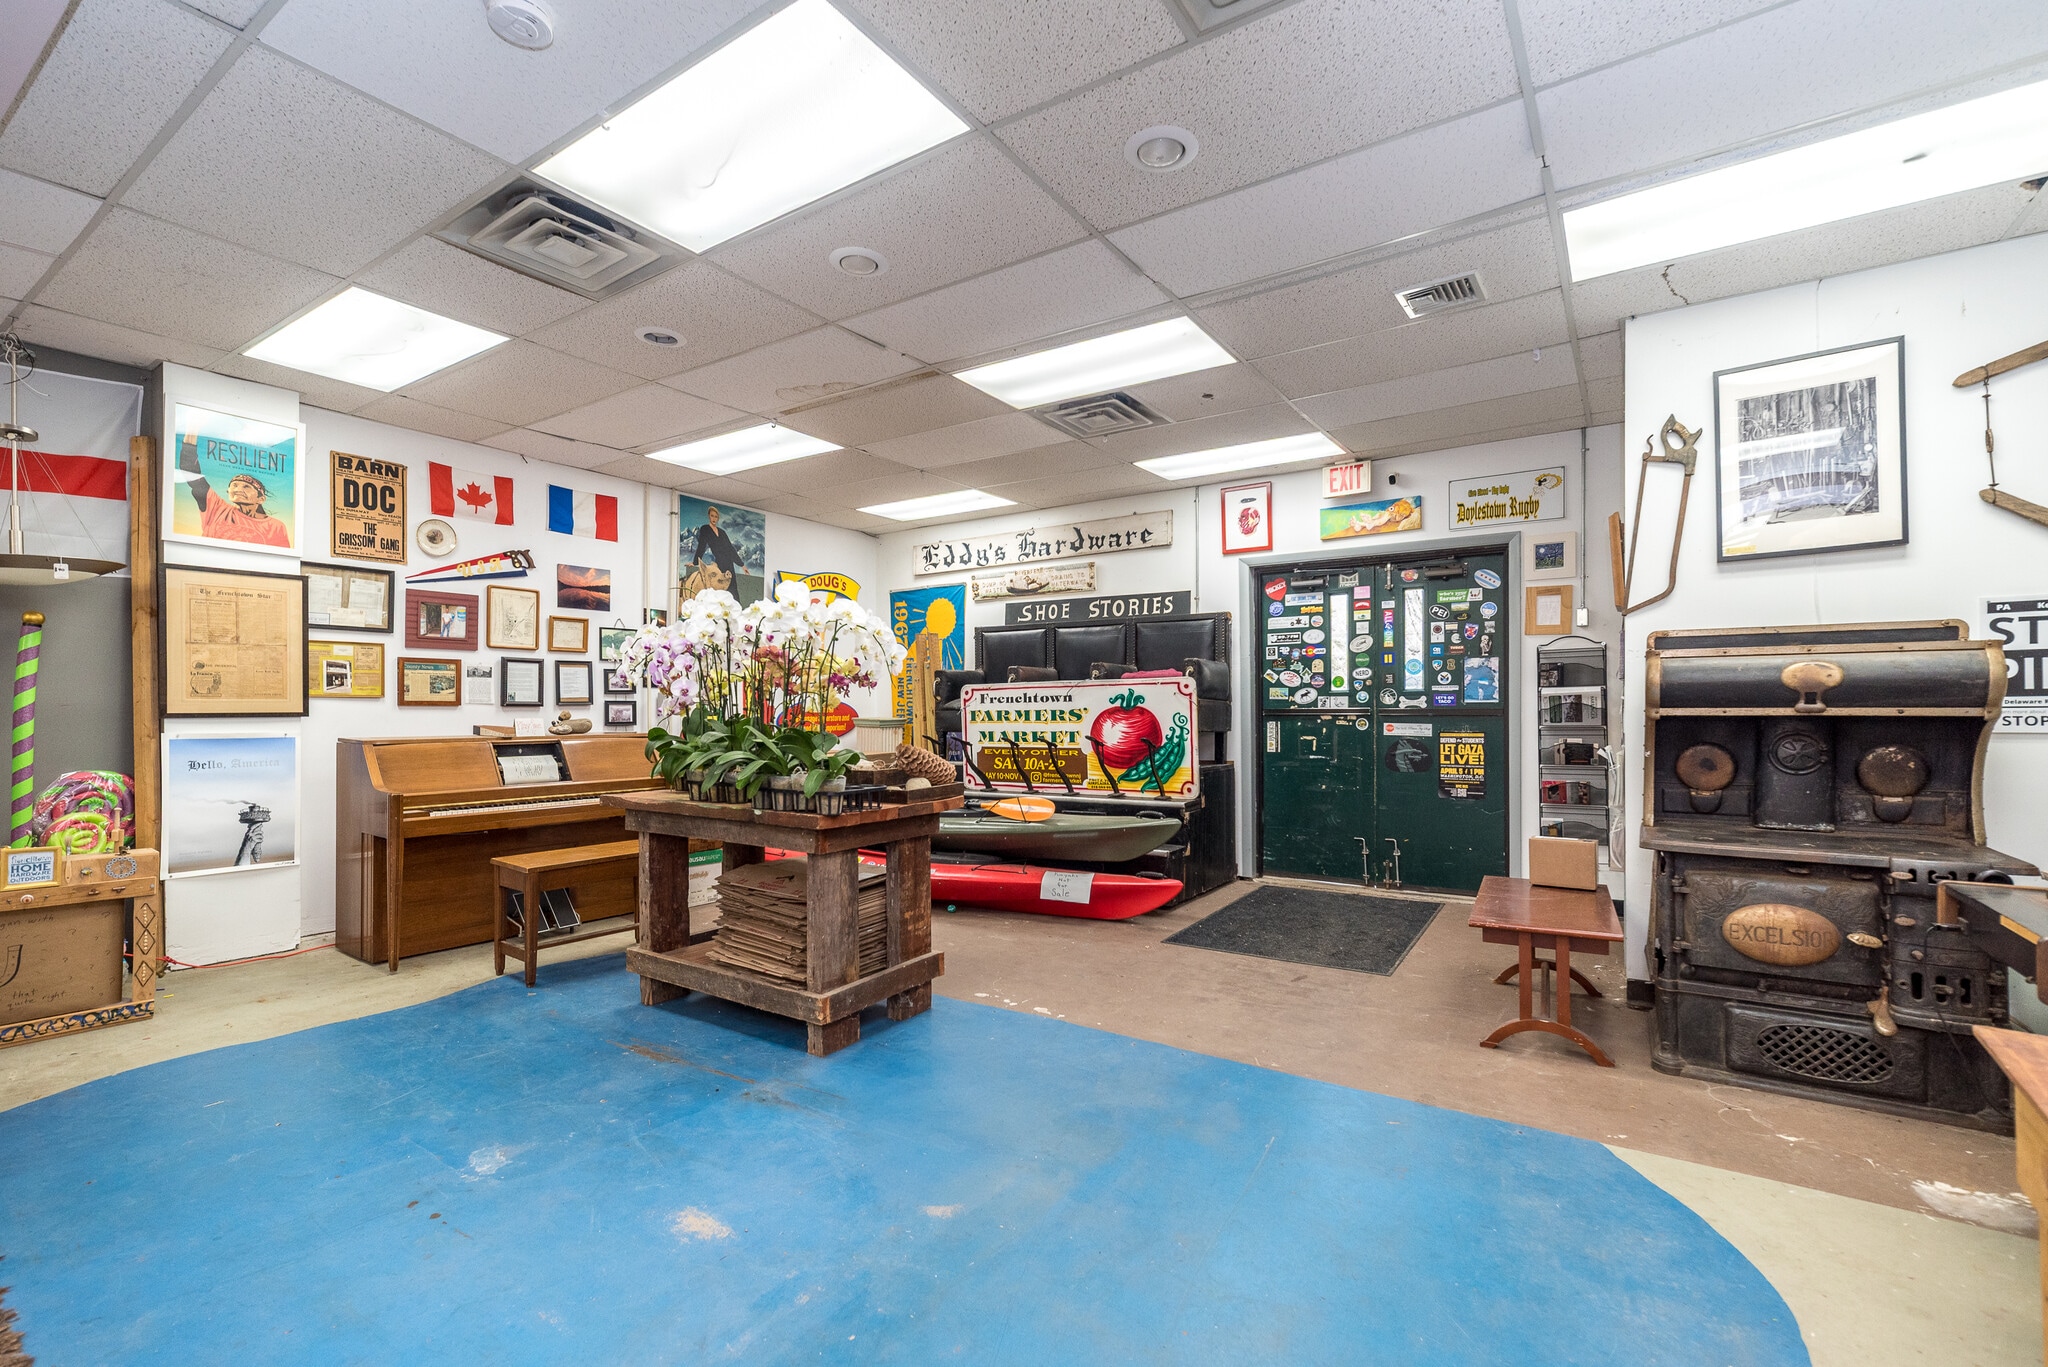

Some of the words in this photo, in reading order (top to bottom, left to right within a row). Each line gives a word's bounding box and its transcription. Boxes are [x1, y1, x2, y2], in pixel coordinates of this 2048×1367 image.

[206, 440, 288, 473] RESILIENT
[338, 456, 399, 478] BARN
[1330, 464, 1363, 493] EXIT
[343, 478, 396, 514] DOC
[1457, 501, 1507, 525] Doylestown
[1509, 495, 1540, 520] Rugby
[363, 522, 378, 536] THE
[339, 532, 377, 549] GRISSOM
[380, 538, 401, 552] GANG
[922, 543, 1006, 572] Eddy's
[1016, 527, 1154, 562] Hardware
[1018, 603, 1070, 622] SHOE
[1088, 596, 1174, 618] STORIES
[1431, 606, 1448, 618] PEI
[893, 600, 908, 650] 1967
[897, 677, 905, 698] NEW
[980, 692, 1073, 704] Frenchtown
[969, 707, 1089, 725] FARMERS'
[978, 730, 1081, 746] MARKET
[1440, 744, 1456, 755] LET
[1458, 744, 1484, 756] GAZA
[1440, 754, 1484, 765] LIVE!
[187, 760, 227, 772] Hello,
[231, 758, 280, 769] America
[11, 863, 51, 874] HOME
[1051, 888, 1070, 897] Sale
[1729, 923, 1835, 948] EXCELSIOR
